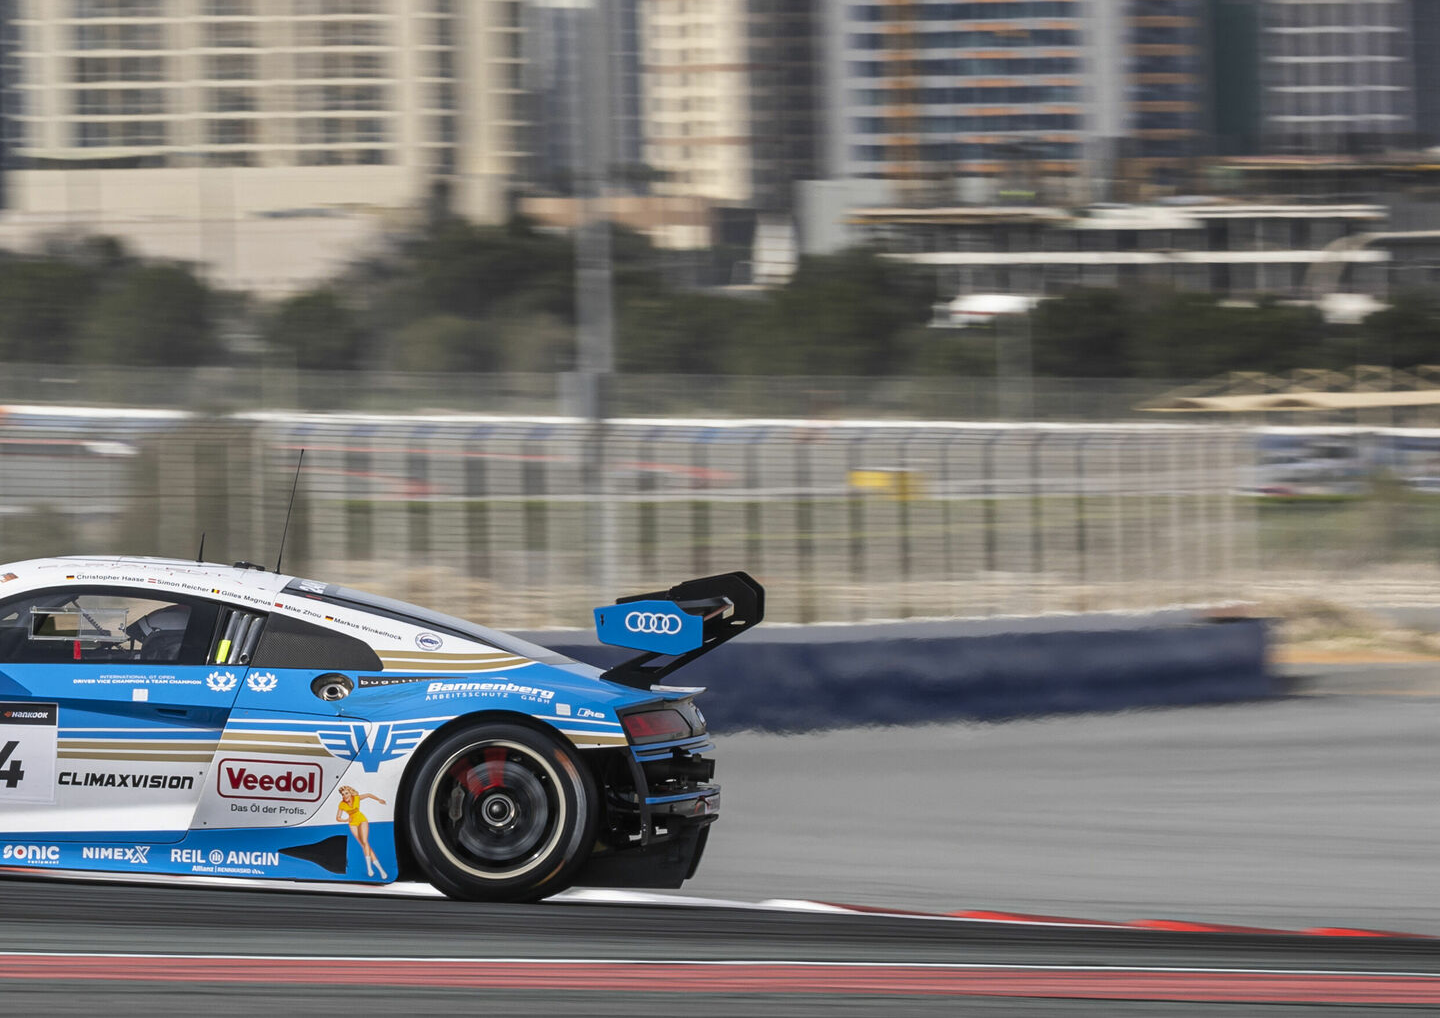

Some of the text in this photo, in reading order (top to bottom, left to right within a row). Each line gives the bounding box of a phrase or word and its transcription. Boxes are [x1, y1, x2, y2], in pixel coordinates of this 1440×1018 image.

[157, 579, 209, 592] Simon Reicher
[221, 590, 272, 606] Gilles Magnus
[284, 604, 322, 619] Mike Zhou
[333, 617, 402, 641] Markus Winkelhock
[425, 691, 509, 701] ARBEITSSCHUTZ
[426, 682, 555, 699] Bannenberg
[225, 766, 315, 794] Veedol
[230, 803, 249, 812] Das
[262, 805, 277, 814] der
[279, 805, 307, 815] Profis.
[170, 848, 280, 866] REIL ANGIN
